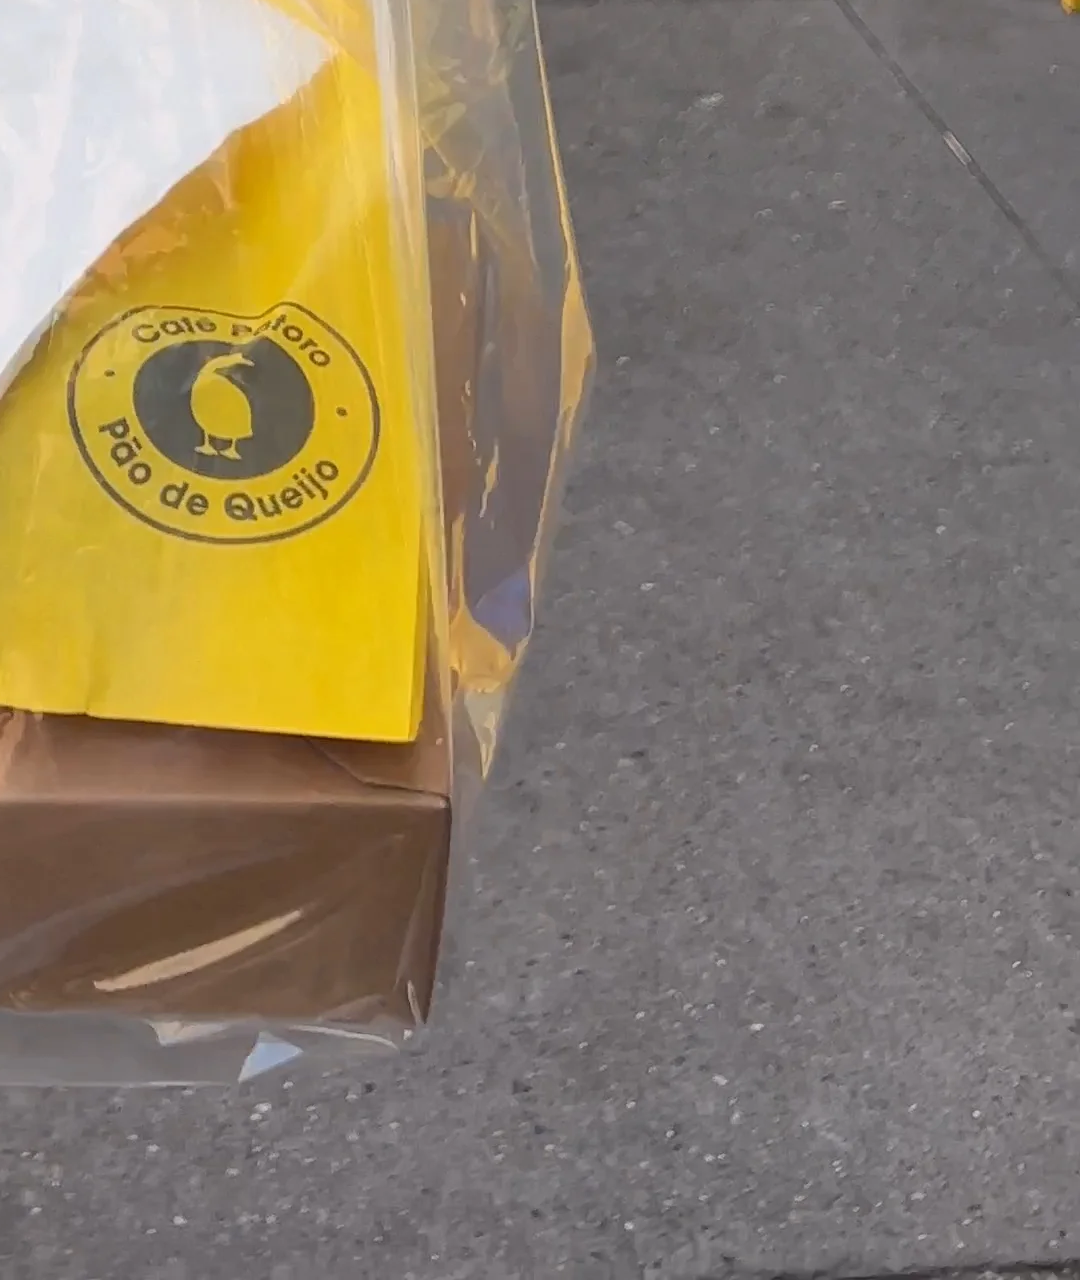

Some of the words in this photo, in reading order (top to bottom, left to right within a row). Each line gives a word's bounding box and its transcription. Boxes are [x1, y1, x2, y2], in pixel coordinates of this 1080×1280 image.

[97, 416, 152, 485] Pão
[159, 481, 210, 516] de
[224, 460, 339, 522] Queijo
